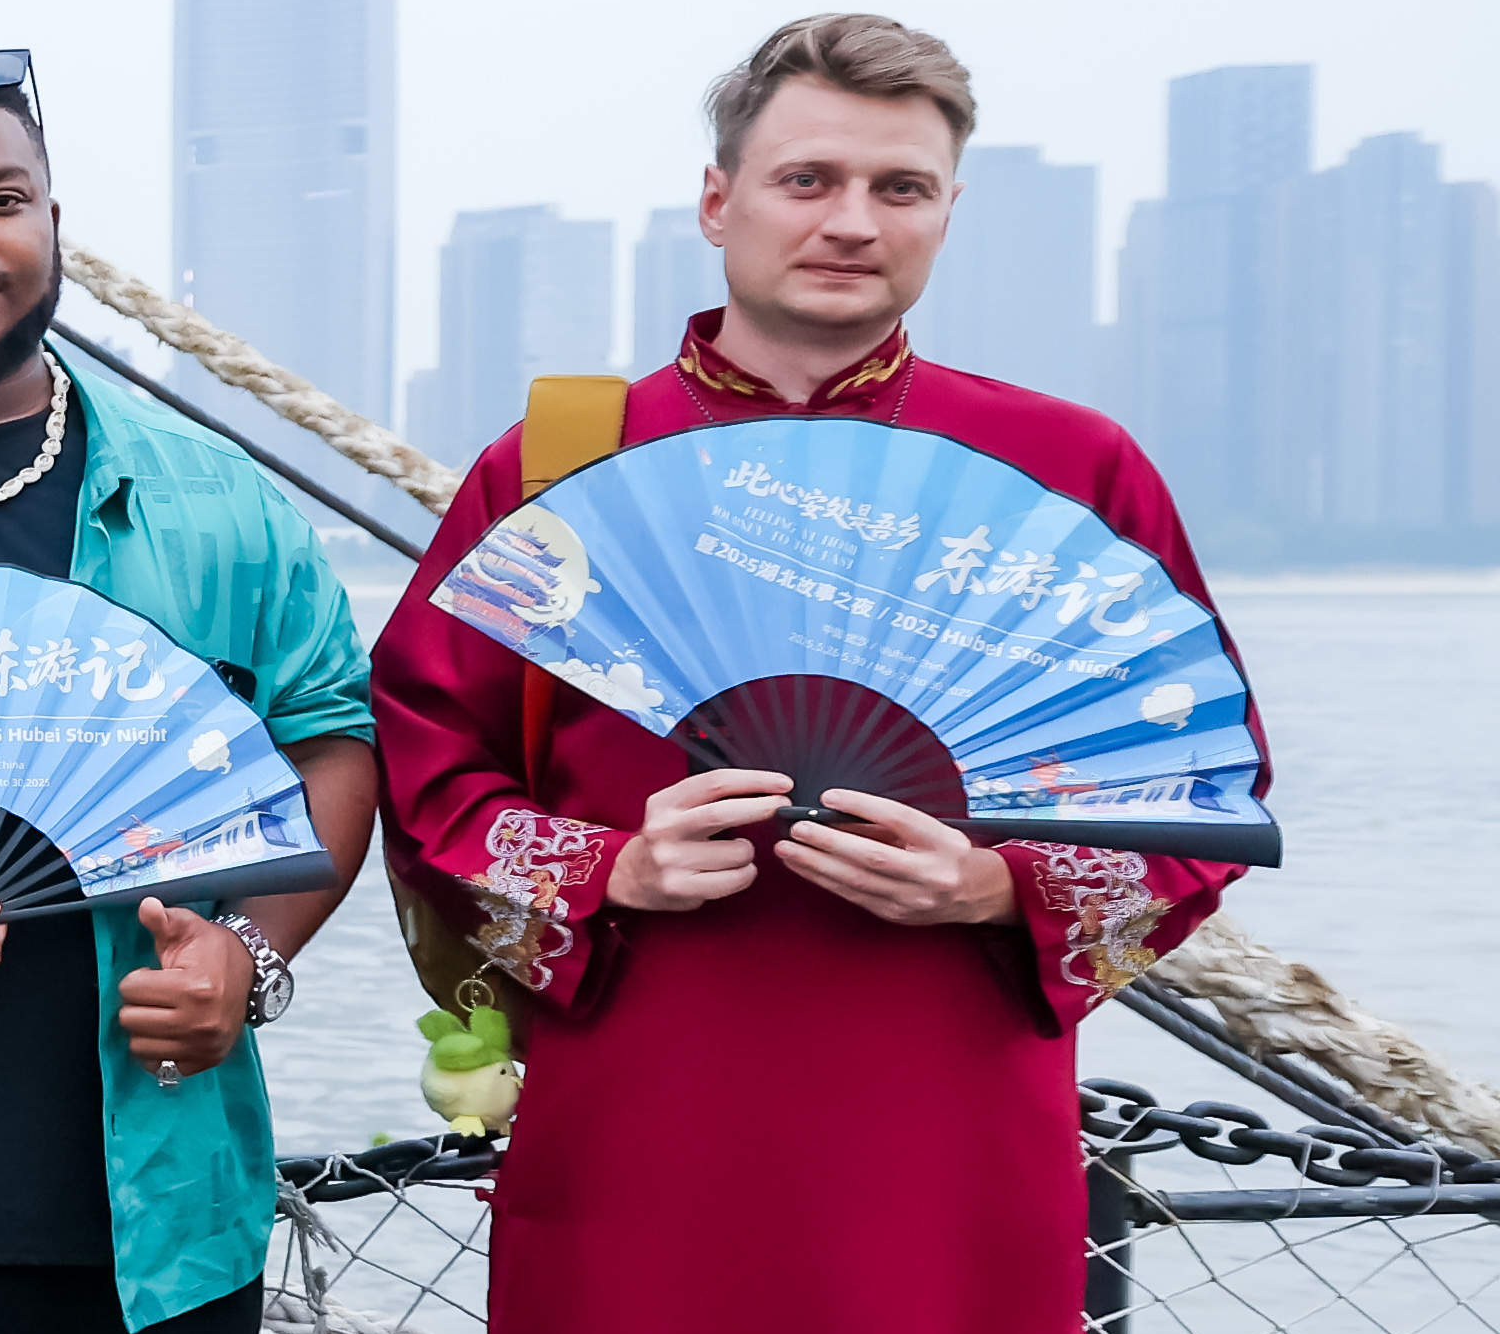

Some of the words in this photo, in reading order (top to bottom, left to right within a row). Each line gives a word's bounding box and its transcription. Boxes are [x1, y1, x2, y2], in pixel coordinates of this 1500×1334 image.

[914, 525, 1155, 636] 东游记
[890, 612, 940, 639] 2025
[940, 628, 1004, 658] Hubei
[1007, 644, 1066, 673] Story
[1067, 658, 1132, 682] Night
[8, 726, 60, 743] Hubei
[66, 726, 112, 747] Story
[116, 726, 168, 746] Night
